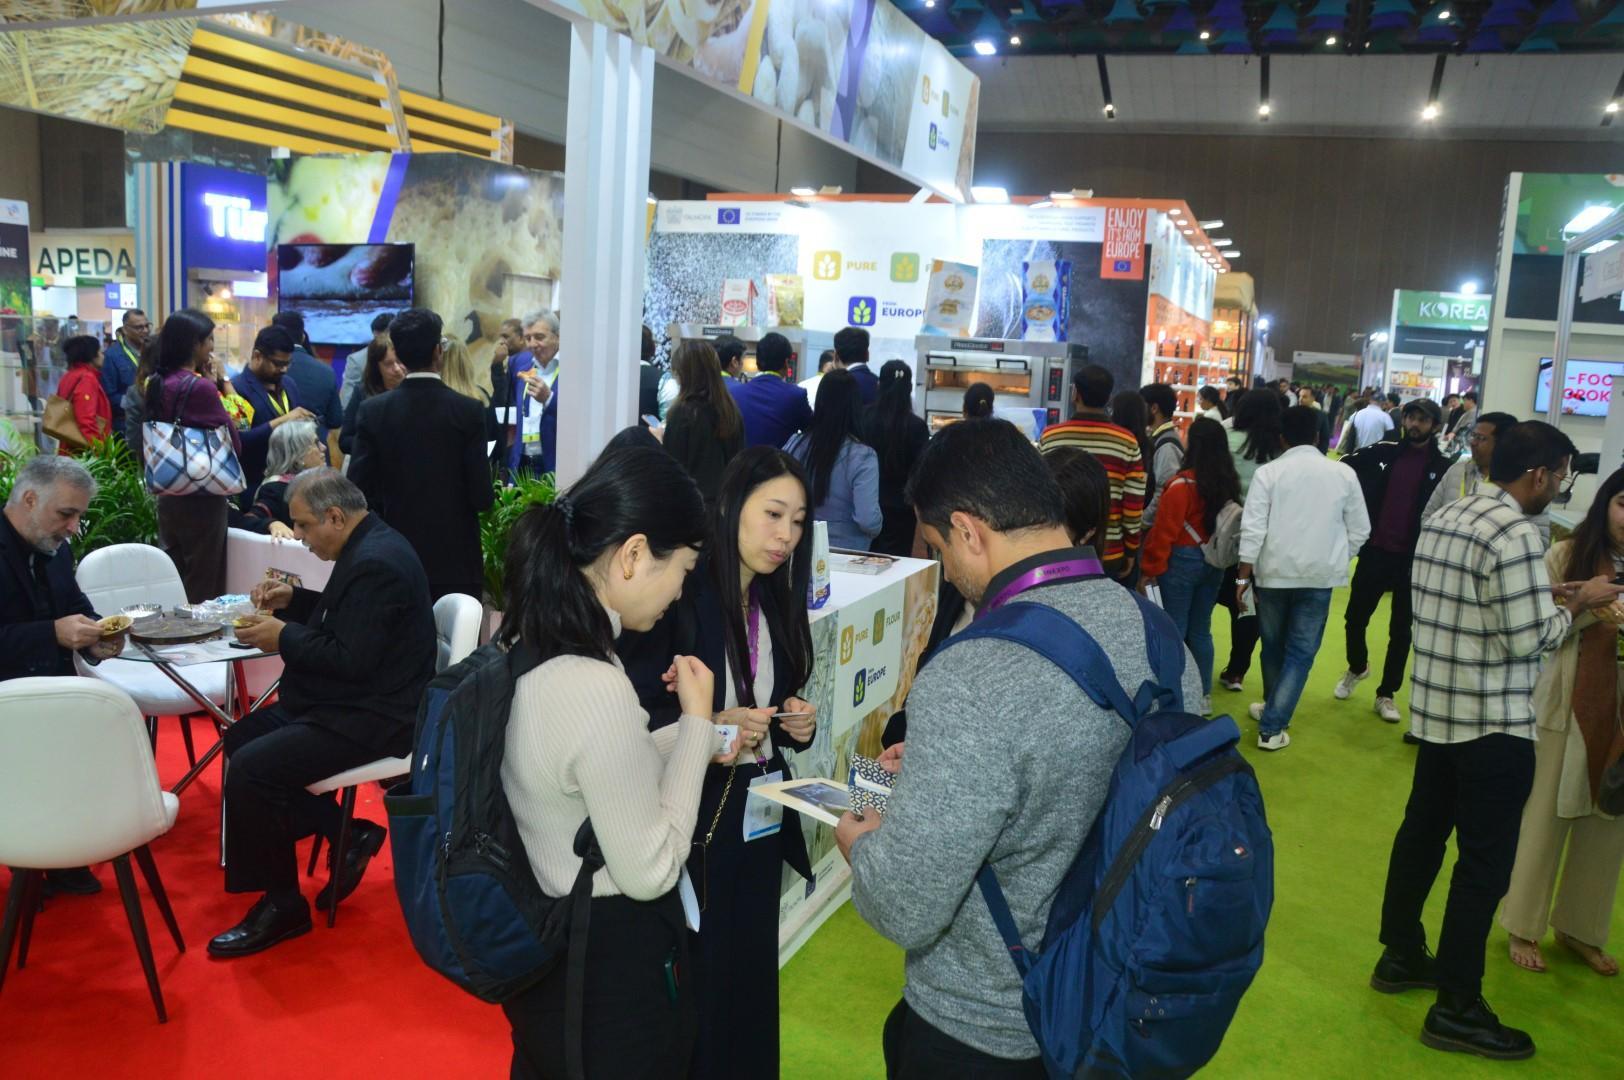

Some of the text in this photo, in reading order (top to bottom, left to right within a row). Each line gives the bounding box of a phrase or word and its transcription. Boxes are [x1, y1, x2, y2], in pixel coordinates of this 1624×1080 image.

[1107, 208, 1144, 228] ENJOY
[1122, 228, 1142, 242] FROM
[1105, 241, 1141, 258] EUROPE
[37, 247, 133, 275] APEDA
[846, 261, 878, 272] PURE
[882, 307, 926, 317] EUROP
[1419, 301, 1488, 320] KOREA
[855, 611, 900, 643] PURE FLOUR
[867, 666, 886, 686] EUROPE
